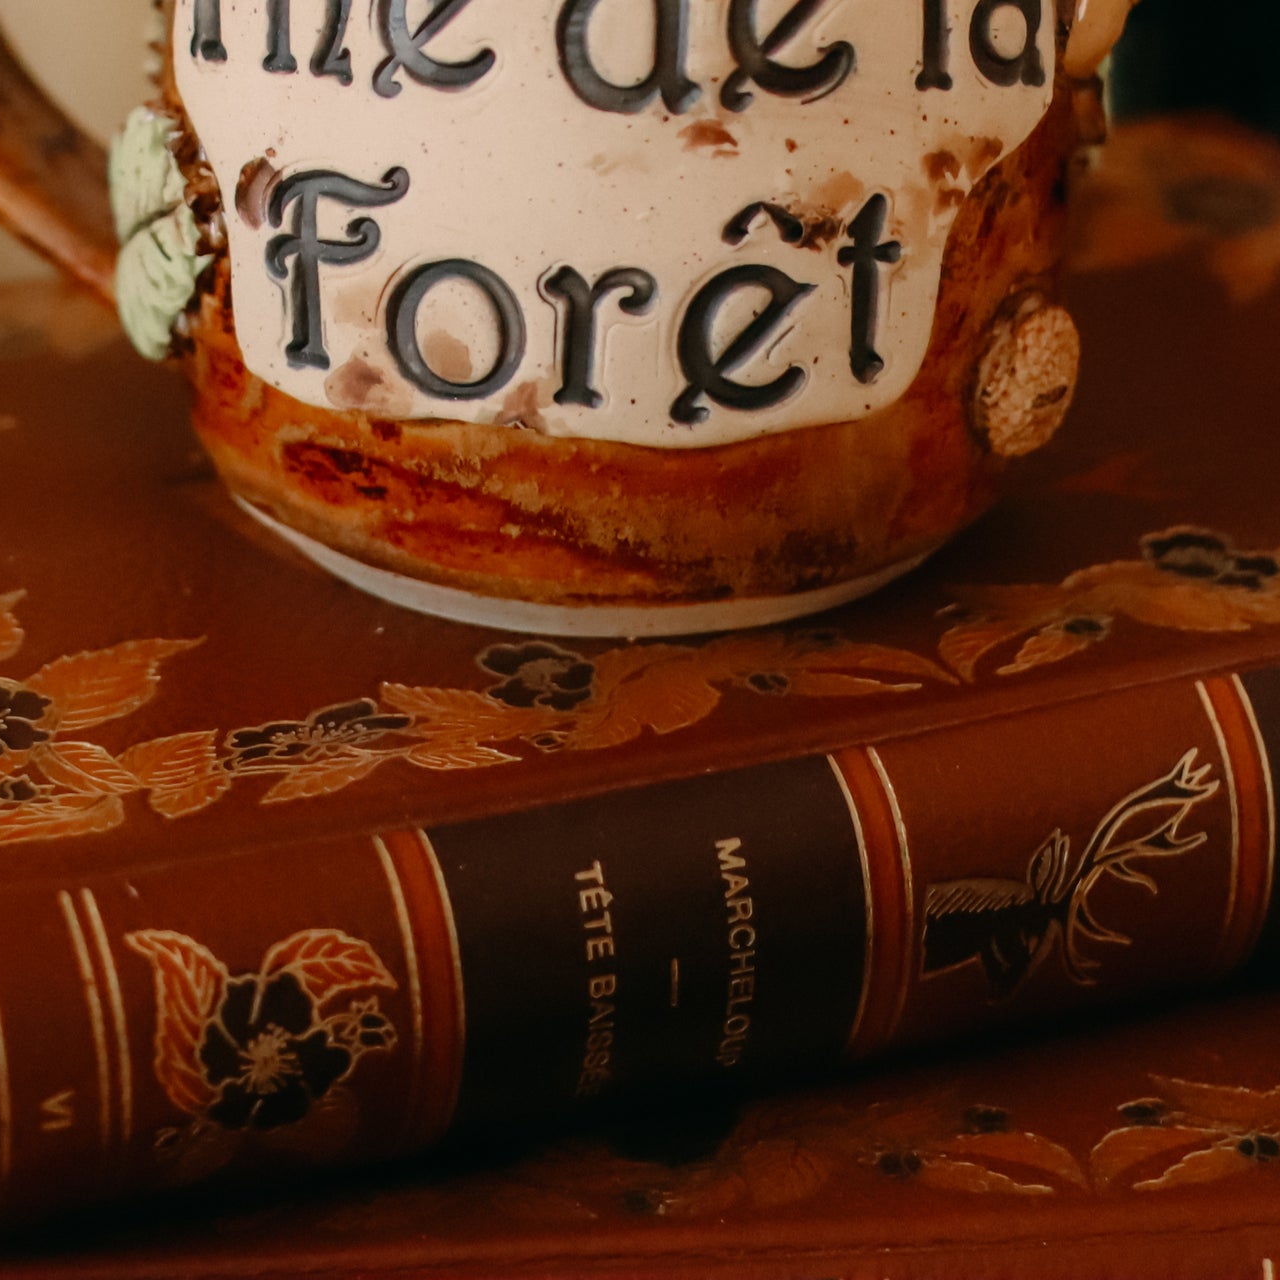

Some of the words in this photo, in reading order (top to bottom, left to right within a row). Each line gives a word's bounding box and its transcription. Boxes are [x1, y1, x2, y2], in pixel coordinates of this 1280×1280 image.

[265, 165, 902, 425] Forêt
[574, 859, 615, 961] TÊTE
[714, 836, 756, 1067] MARCHELOUP
